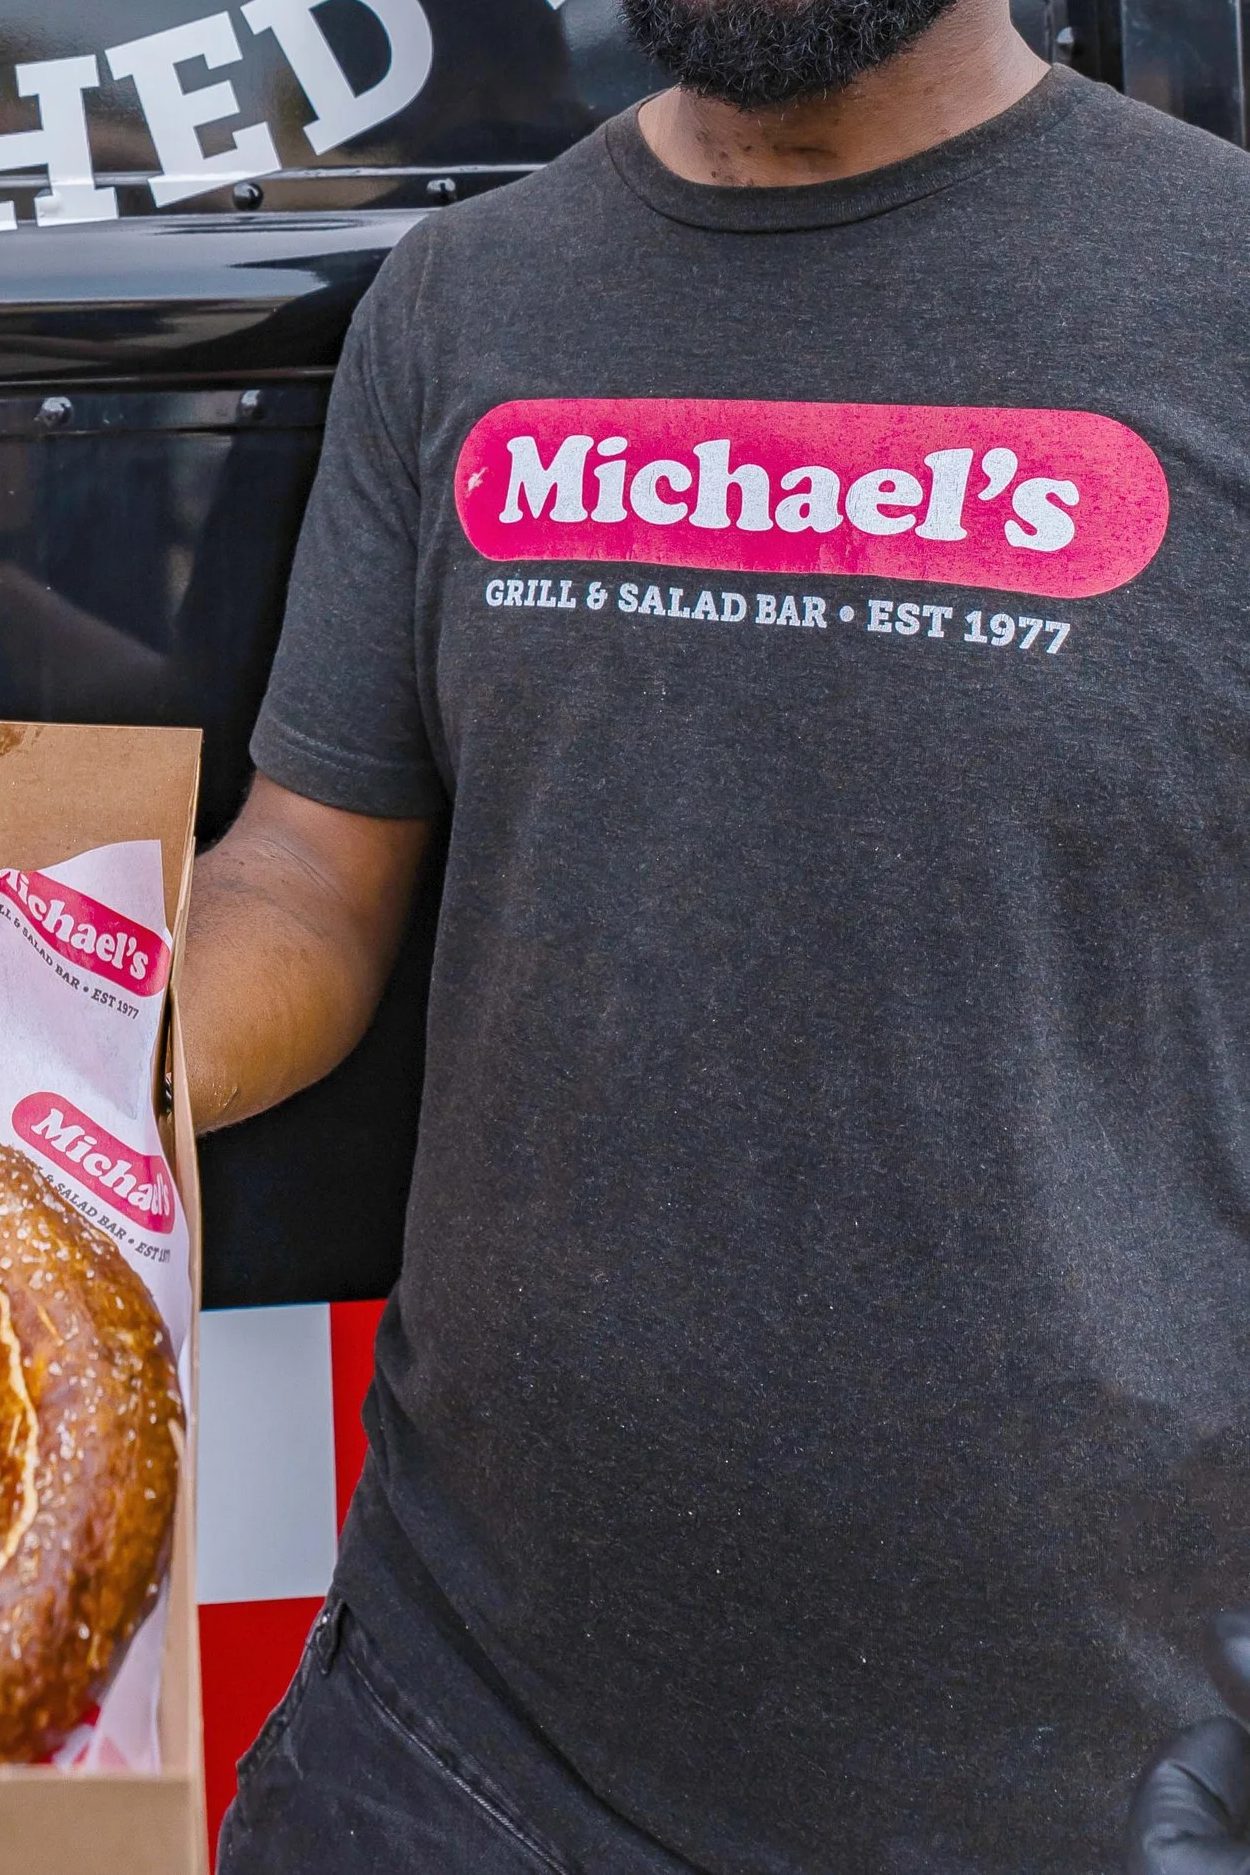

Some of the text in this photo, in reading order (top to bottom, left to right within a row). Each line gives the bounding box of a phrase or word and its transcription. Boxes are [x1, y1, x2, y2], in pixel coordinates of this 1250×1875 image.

[498, 434, 1080, 552] Michael's
[485, 579, 1072, 655] GRILL & SALAD BAR EST 1977
[13, 917, 21, 929] &
[22, 928, 54, 967] SALAD
[55, 963, 81, 991] BAR
[91, 988, 117, 1008] EST
[116, 999, 140, 1020] 1977
[54, 1182, 98, 1218] SALAD
[97, 1215, 128, 1241] BAR
[135, 1241, 160, 1261] EST
